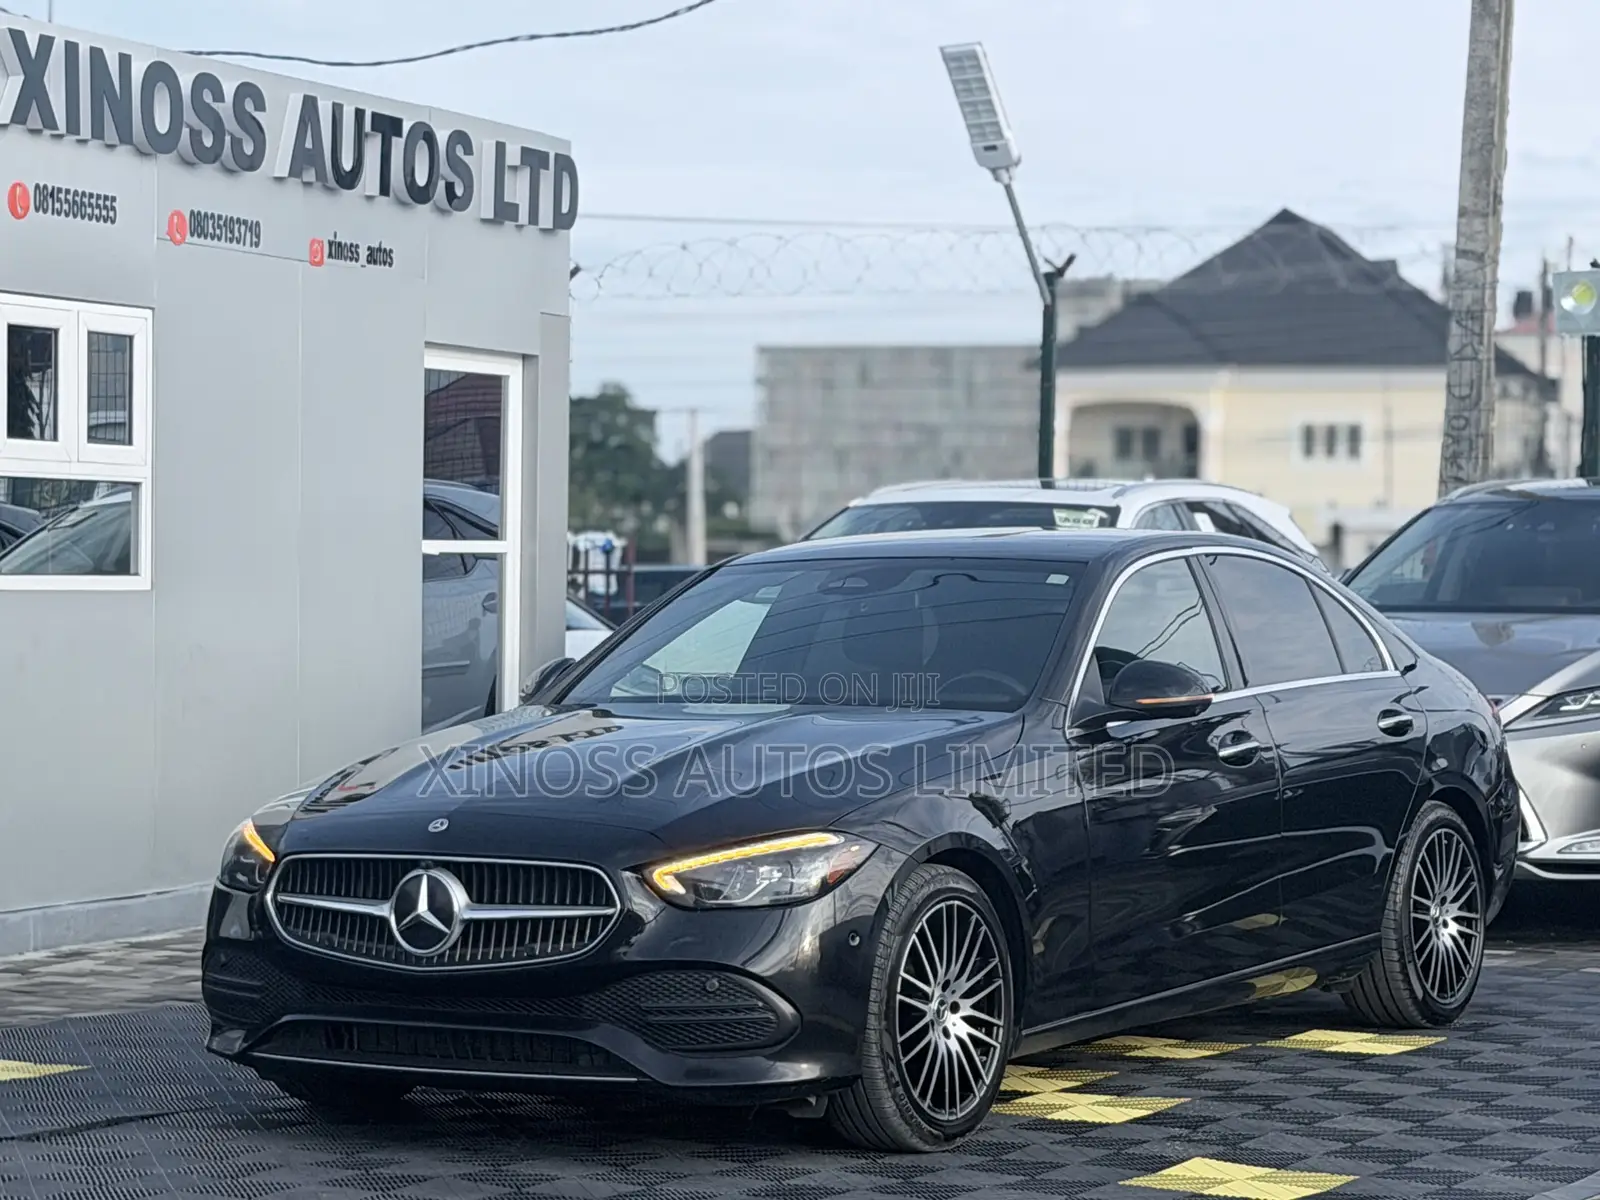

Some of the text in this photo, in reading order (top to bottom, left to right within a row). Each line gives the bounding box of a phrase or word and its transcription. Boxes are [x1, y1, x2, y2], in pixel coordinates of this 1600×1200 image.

[7, 27, 579, 231] XINOSS AUTOS LTD
[33, 182, 118, 225] 08155665555
[188, 209, 261, 248] 08035193719
[327, 231, 394, 268] xinoss_autos
